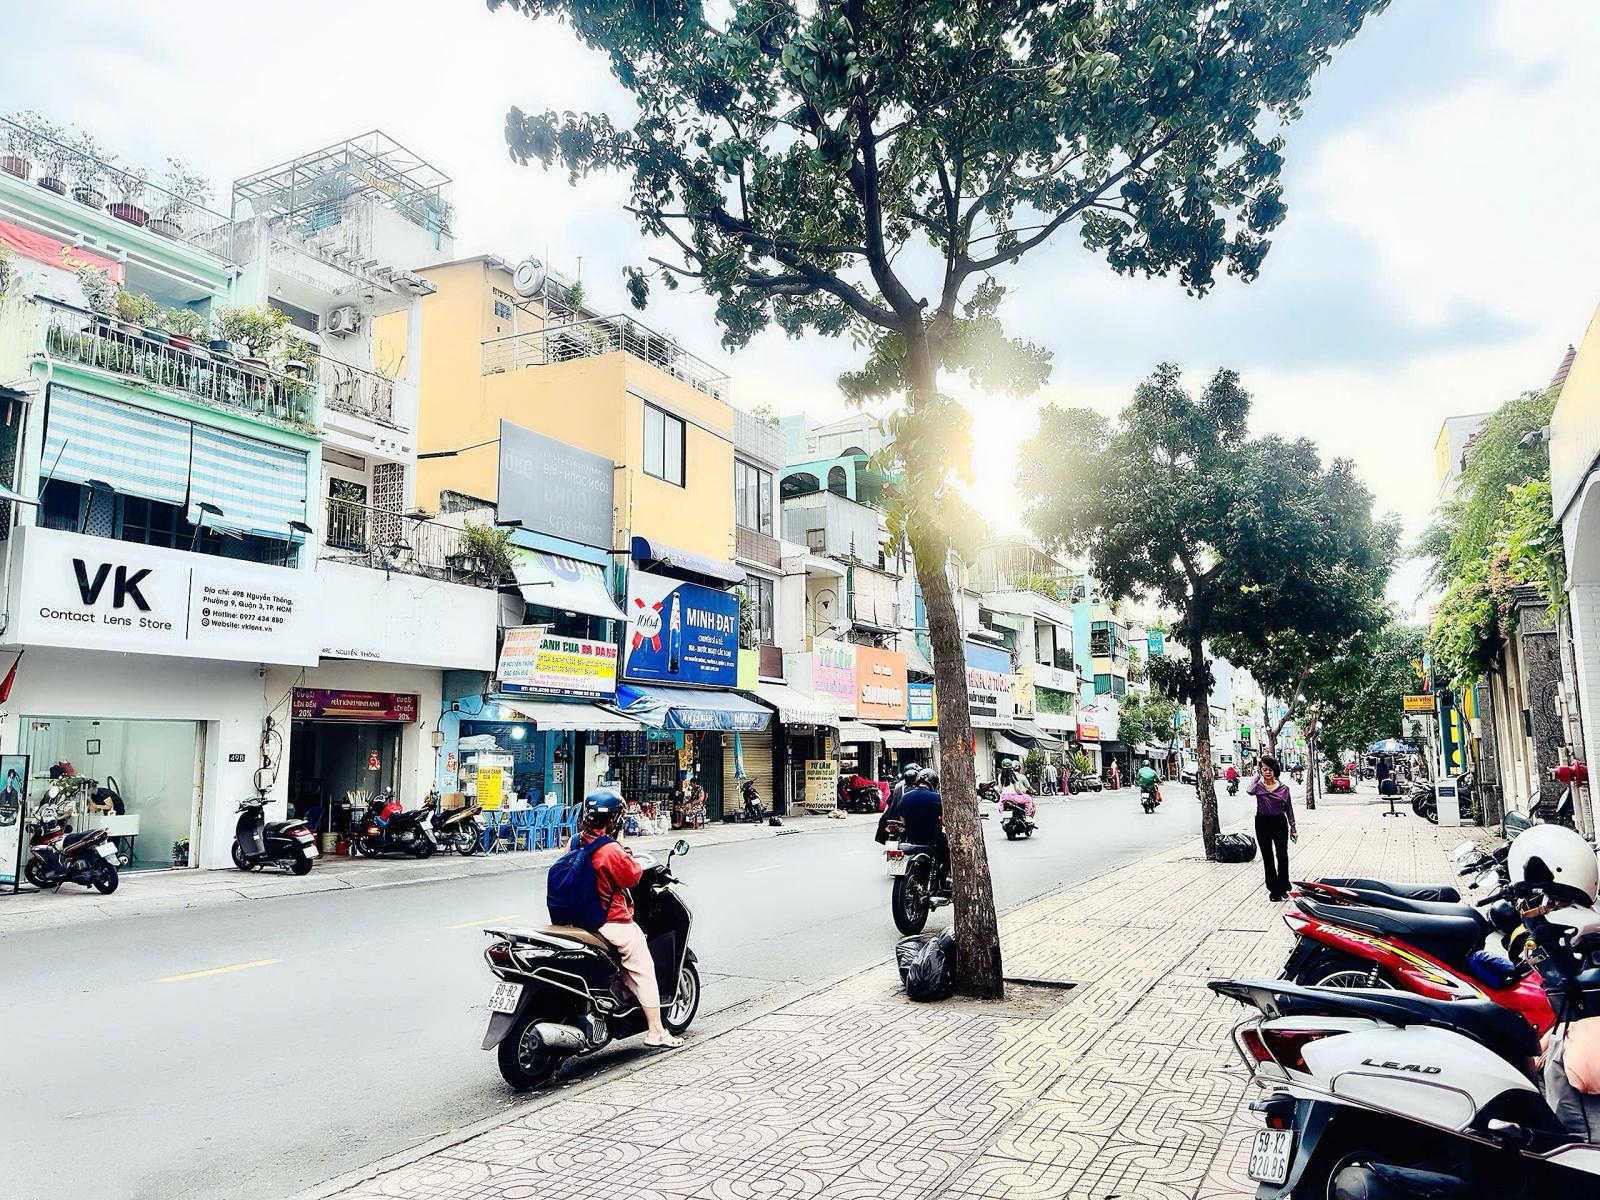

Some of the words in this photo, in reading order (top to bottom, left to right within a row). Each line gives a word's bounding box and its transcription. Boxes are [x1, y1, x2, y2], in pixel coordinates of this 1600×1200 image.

[73, 558, 153, 611] VK
[204, 586, 216, 595] Địa
[218, 588, 230, 596] chỉ:
[232, 590, 245, 598] 49B
[246, 592, 271, 602] Nguyễn
[272, 595, 294, 605] Thông,
[203, 596, 229, 606] Phường
[238, 601, 257, 610] Quận
[39, 607, 96, 624] Contact
[103, 613, 132, 627] Lens
[138, 616, 173, 631] Store
[212, 610, 238, 619] Hotline:
[211, 619, 240, 629] Website:
[636, 614, 660, 629] 1664
[686, 607, 715, 630] MINH
[716, 613, 736, 637] ĐẠT
[335, 648, 358, 657] NGUYỄN
[360, 650, 381, 659] THÔNG
[293, 700, 305, 708] LÊN
[305, 700, 317, 708] ĐẾN
[356, 700, 369, 708] MINH
[393, 704, 403, 712] LÊN
[298, 709, 312, 718] 20%
[398, 713, 410, 721] 20%
[229, 754, 245, 762] 49B
[1360, 1058, 1442, 1075] LEAD
[1258, 1132, 1286, 1154] 59-X2
[1250, 1155, 1286, 1179] 320.86
